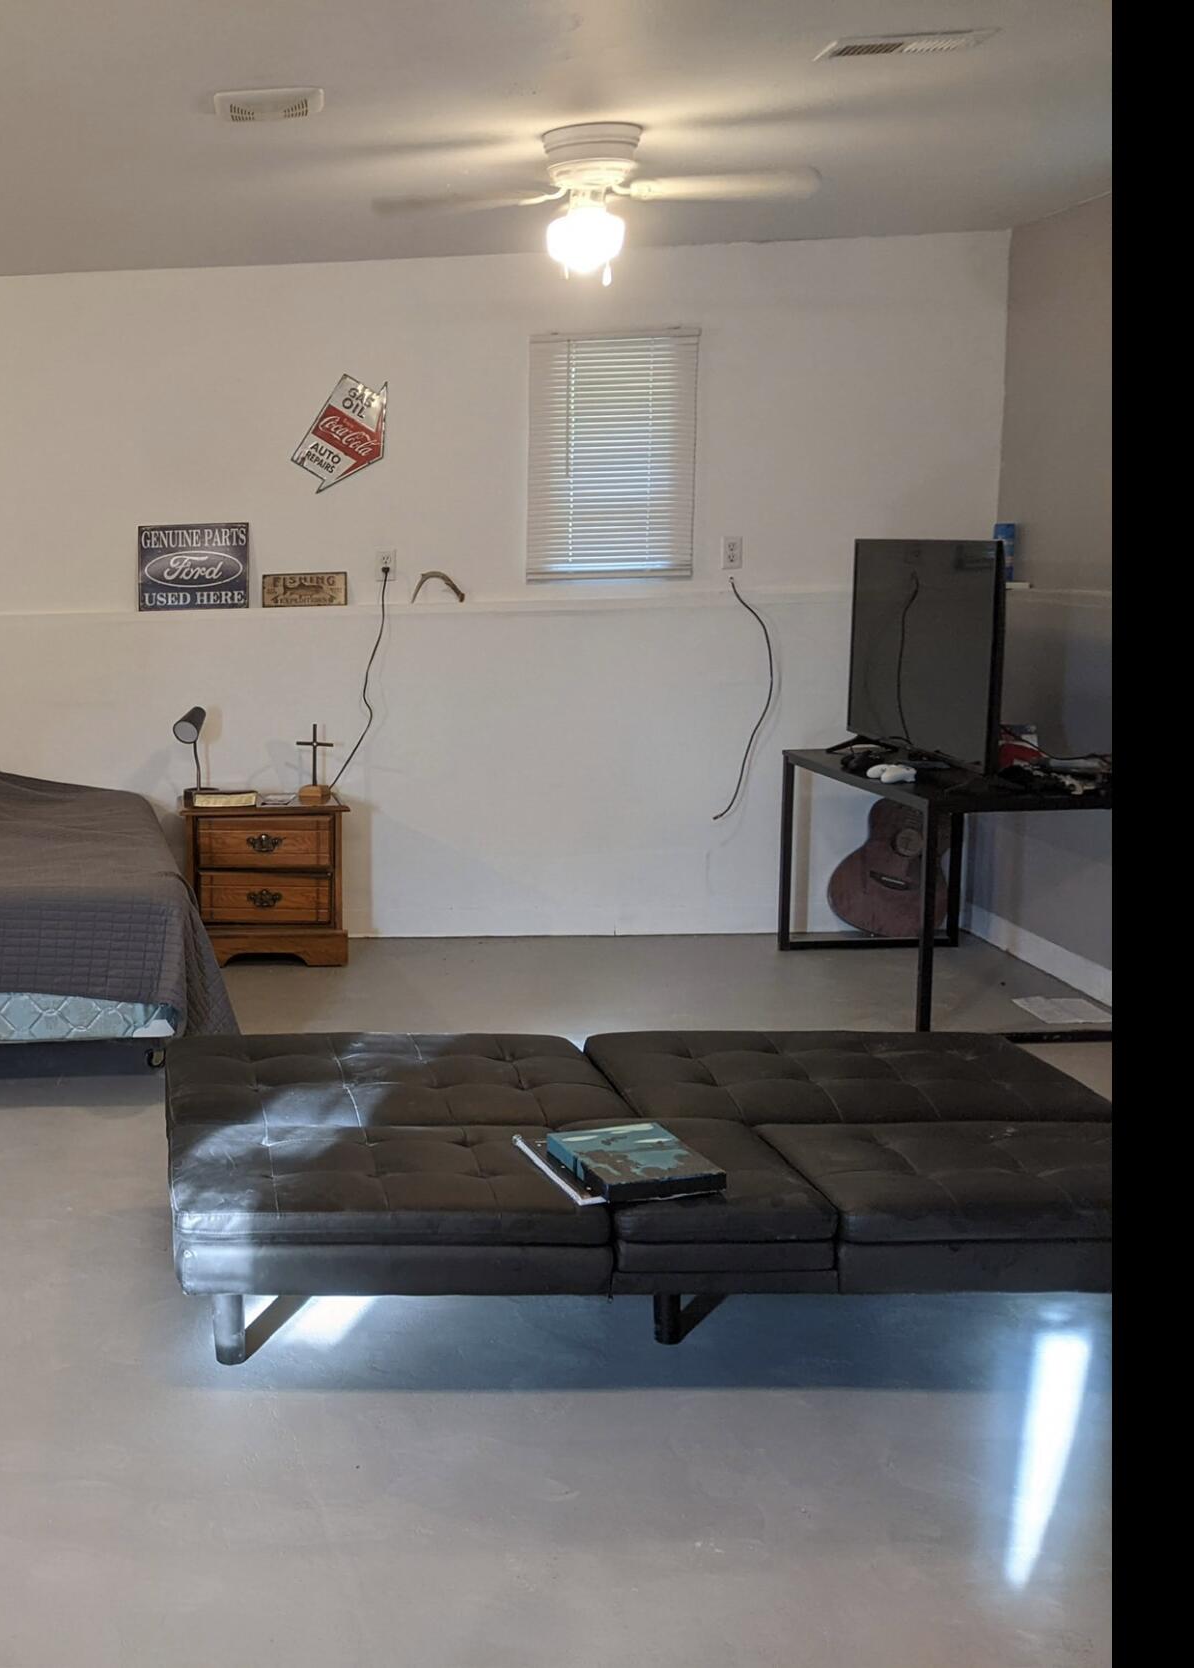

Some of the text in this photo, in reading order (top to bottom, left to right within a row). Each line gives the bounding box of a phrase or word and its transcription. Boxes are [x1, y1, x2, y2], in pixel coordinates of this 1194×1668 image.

[342, 397, 364, 419] OIL
[347, 388, 375, 408] GAS
[306, 450, 335, 474] REPAIRS
[310, 442, 341, 465] AUTO
[141, 527, 246, 549] GENUINE PARTS
[163, 555, 223, 580] Ford
[272, 575, 335, 588] FISHING
[144, 590, 244, 606] USED HERE
